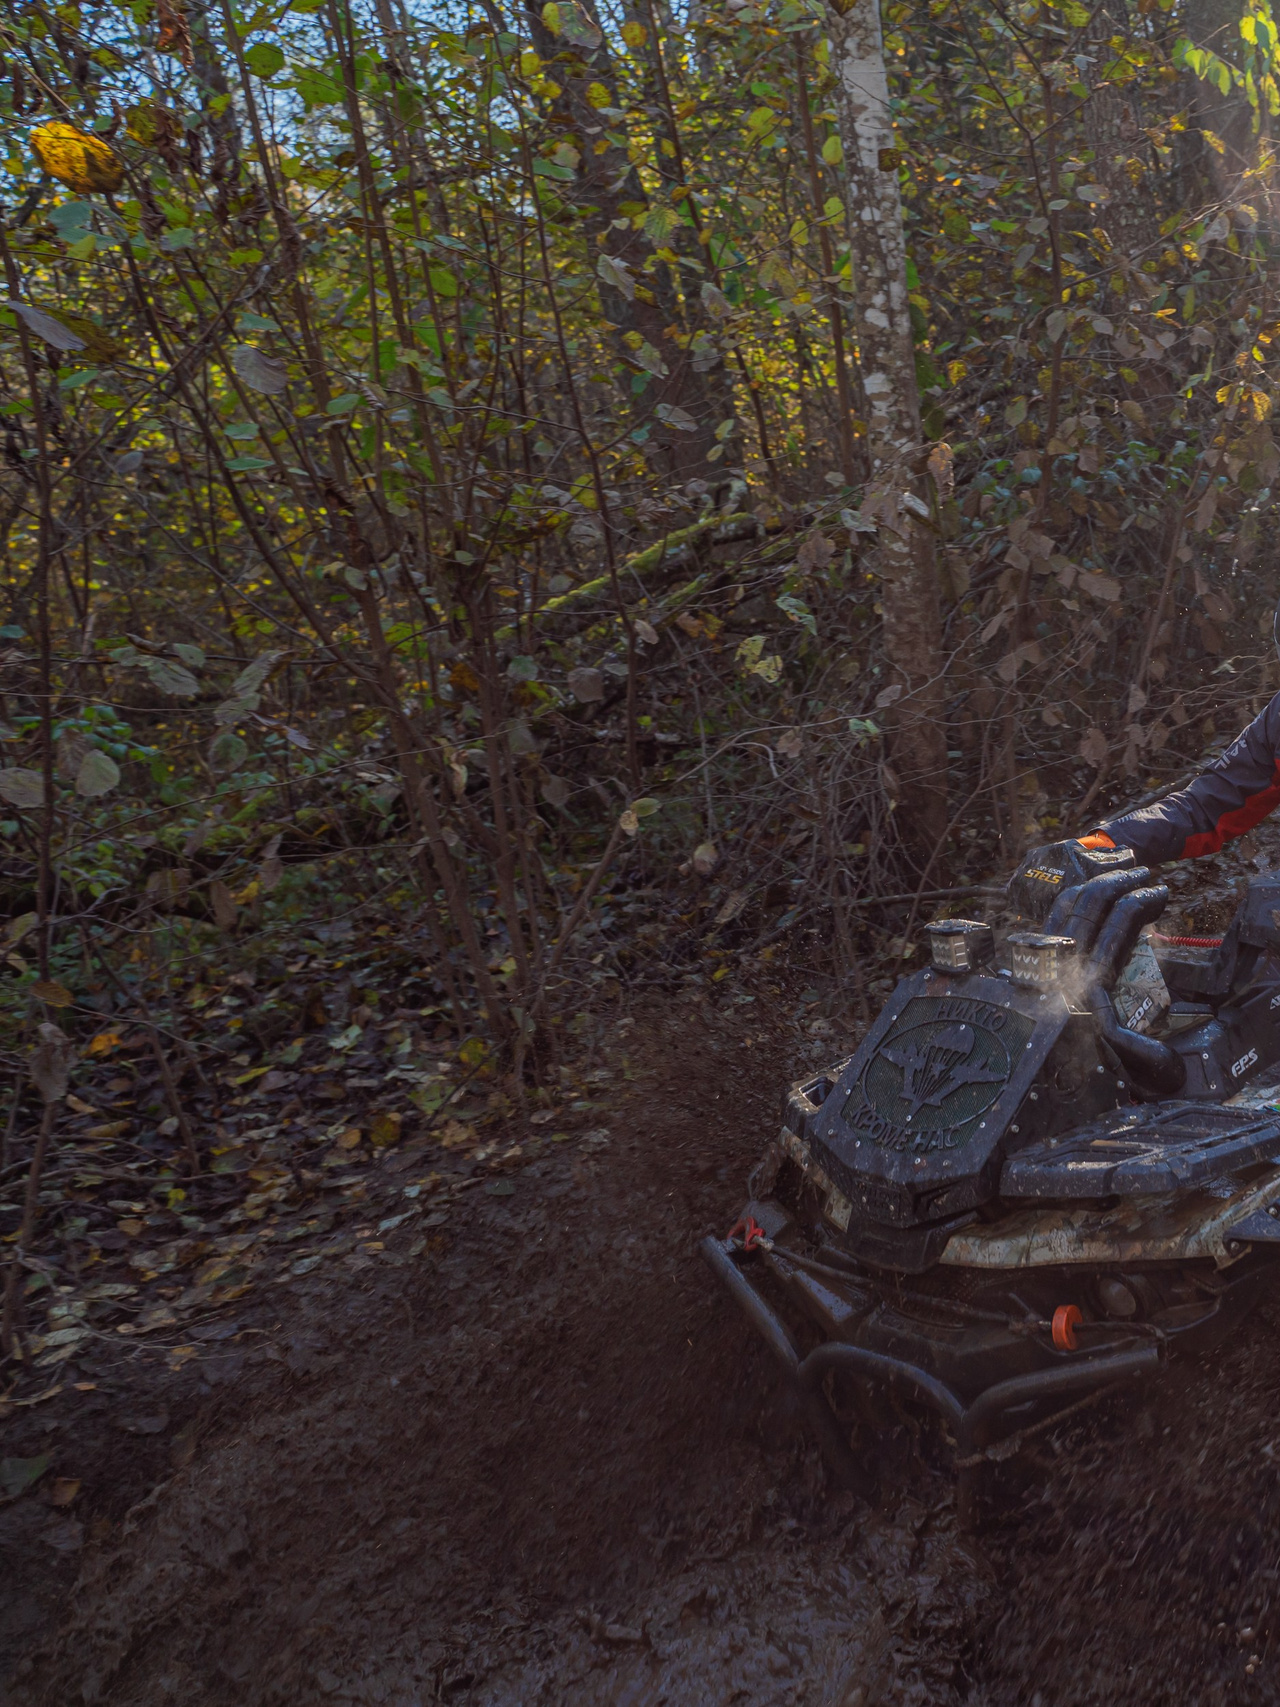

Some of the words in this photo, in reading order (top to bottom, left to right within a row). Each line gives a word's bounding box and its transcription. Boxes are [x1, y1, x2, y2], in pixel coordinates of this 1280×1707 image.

[1024, 869, 1064, 884] STELS
[936, 1000, 1008, 1032] НИКТО
[1126, 996, 1153, 1029] 50G
[1231, 1047, 1259, 1078] EPS
[852, 1105, 910, 1150] КРОМЕ
[913, 1125, 961, 1151] НАС
